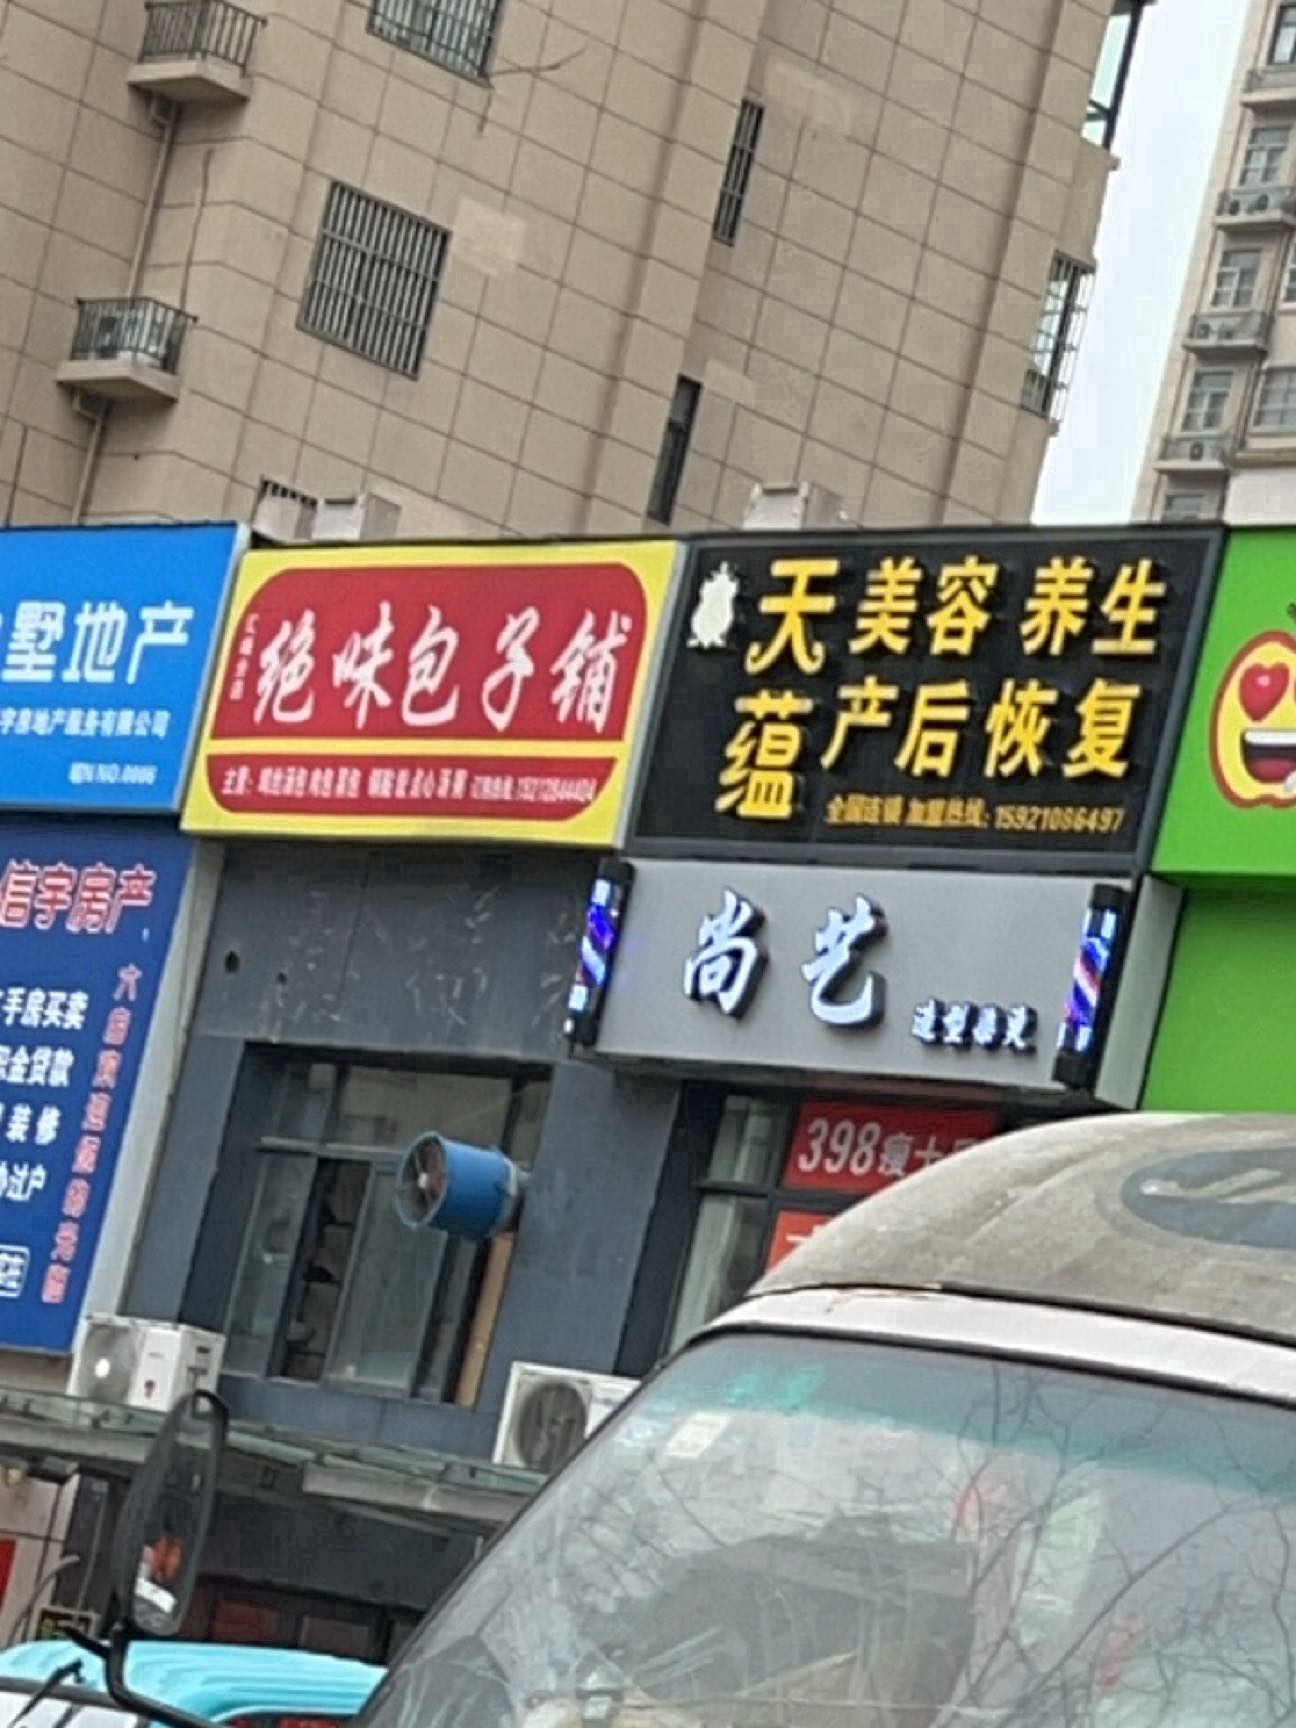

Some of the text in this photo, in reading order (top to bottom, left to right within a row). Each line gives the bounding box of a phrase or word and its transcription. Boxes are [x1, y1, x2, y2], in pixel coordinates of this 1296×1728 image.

[253, 601, 634, 733] 绝味包子铺
[820, 676, 1142, 779] 产后恢复
[683, 886, 882, 1027] 尚艺
